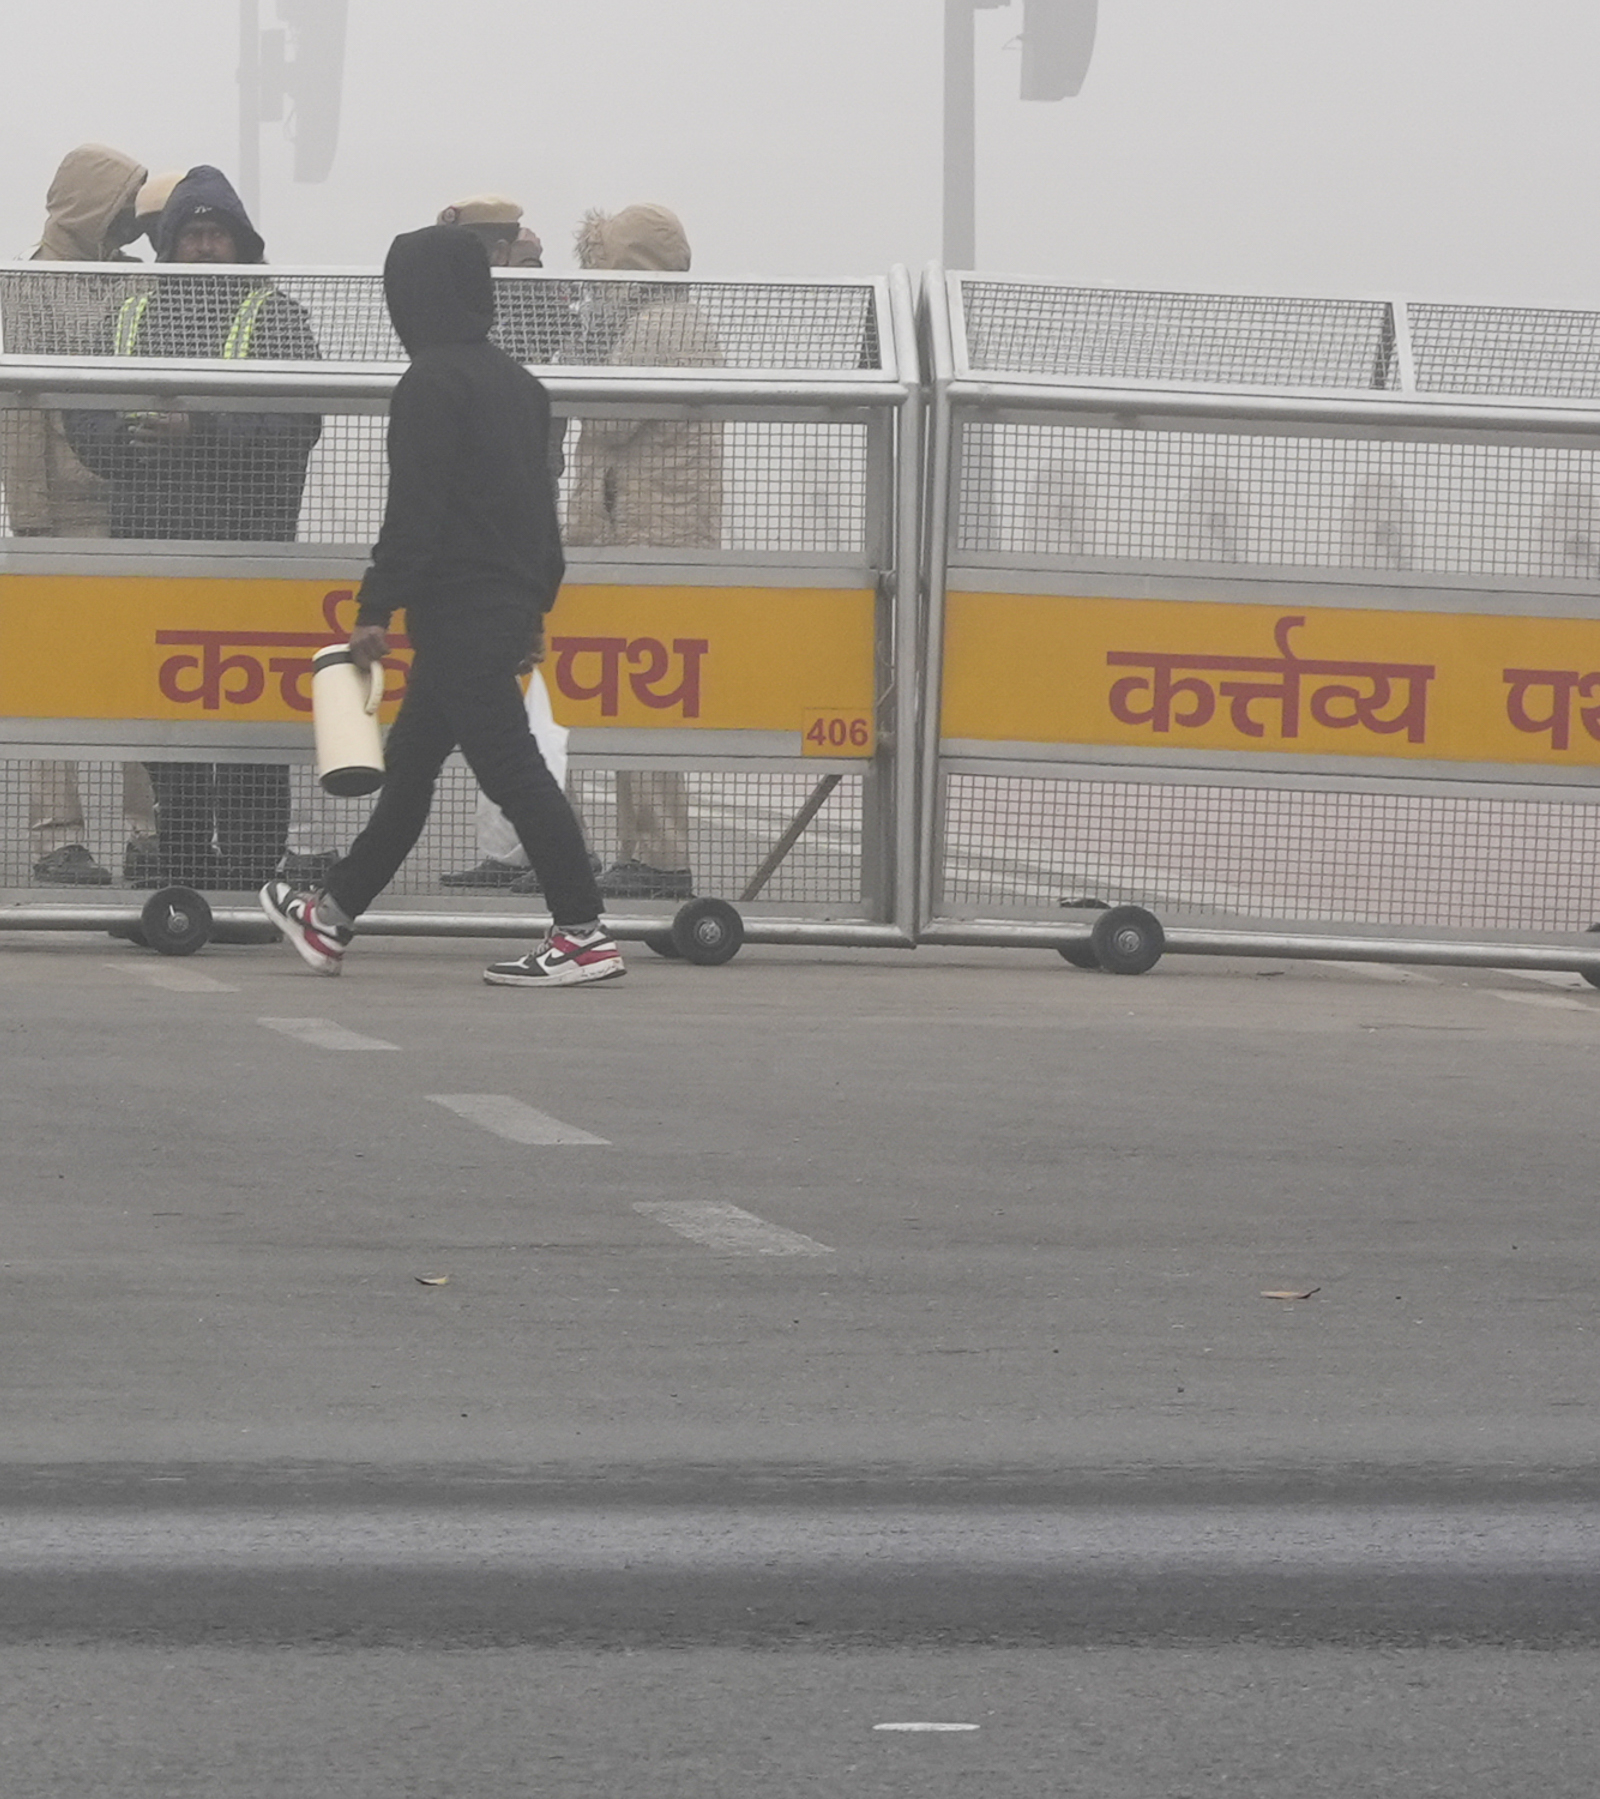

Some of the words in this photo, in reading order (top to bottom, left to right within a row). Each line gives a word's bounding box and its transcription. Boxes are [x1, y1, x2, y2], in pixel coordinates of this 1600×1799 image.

[550, 636, 709, 718] पथ
[1106, 615, 1437, 745] कर्त्तव्य
[805, 717, 869, 748] 406
